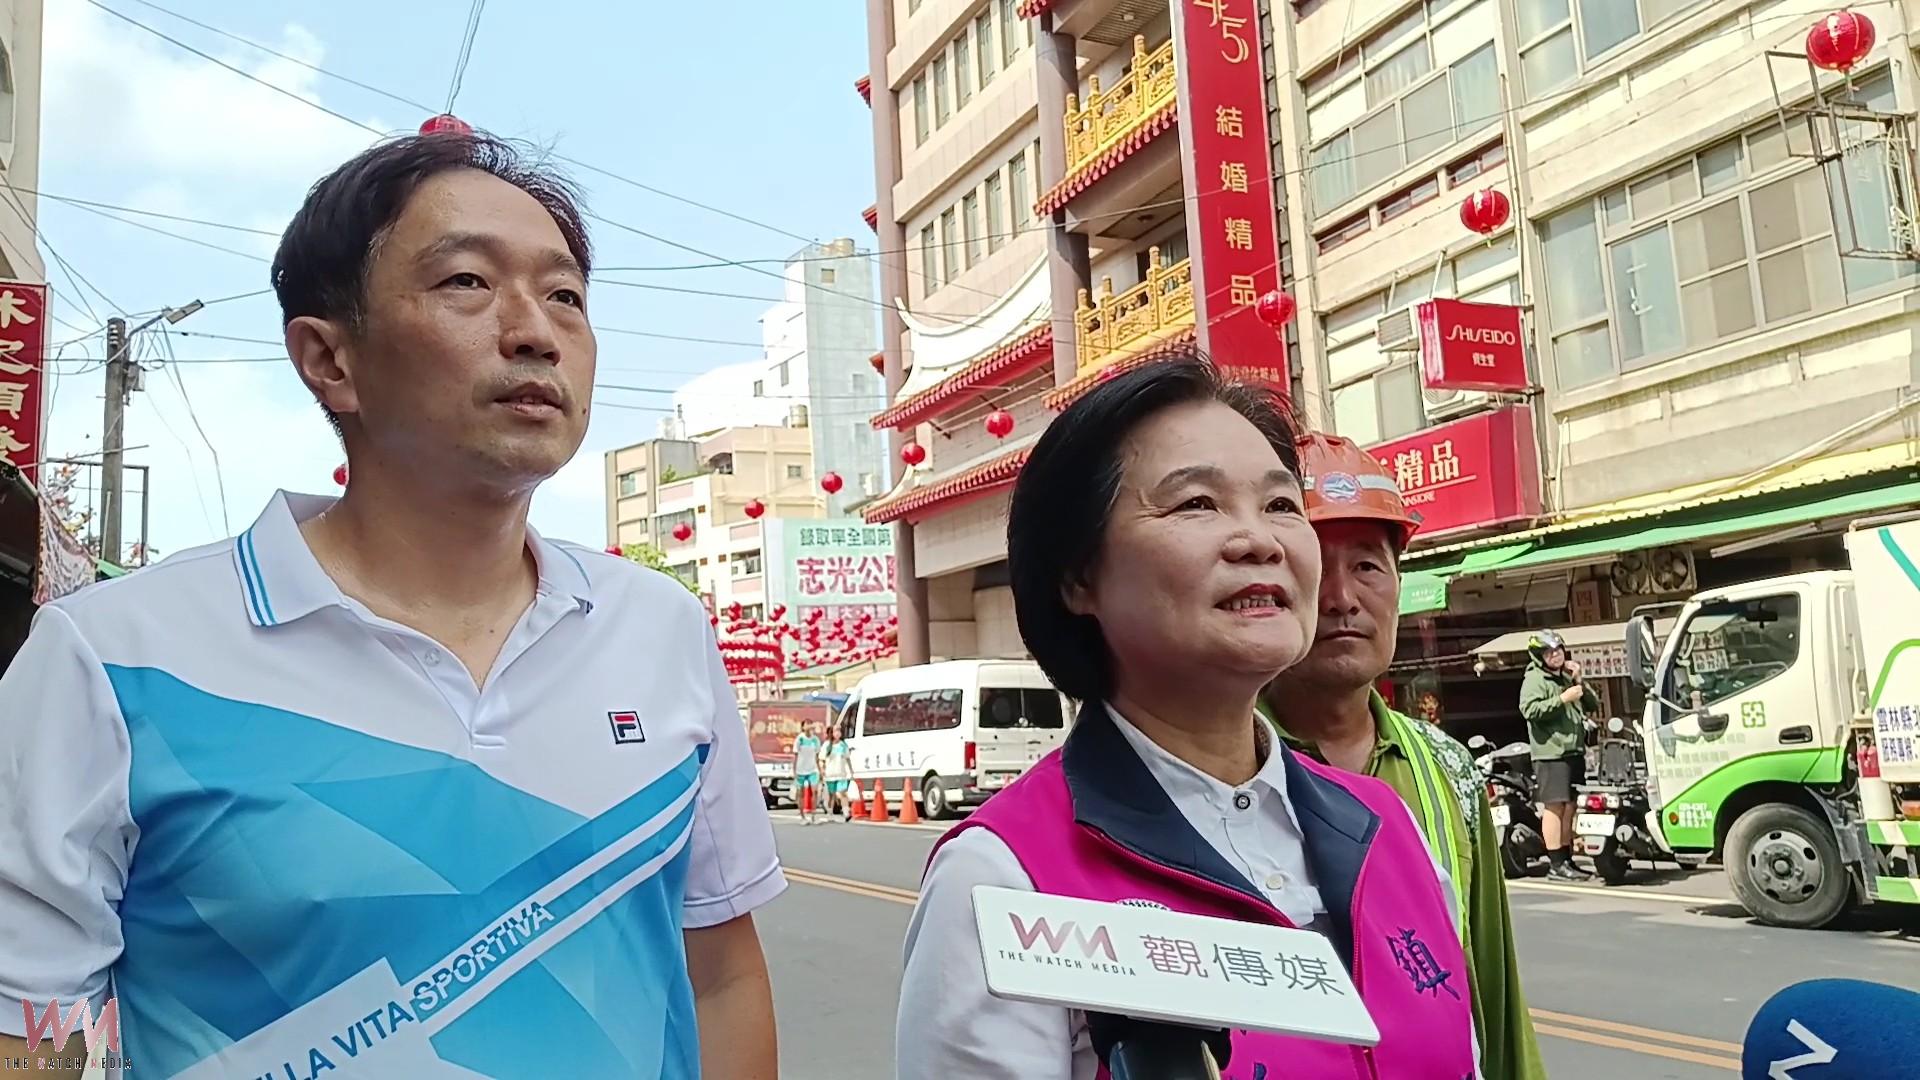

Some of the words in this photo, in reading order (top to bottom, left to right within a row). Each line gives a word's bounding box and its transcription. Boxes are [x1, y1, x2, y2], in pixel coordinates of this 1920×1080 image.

[1206, 105, 1257, 307] 結婚精品
[1445, 324, 1516, 346] SHISEIDO
[1380, 440, 1460, 491] 精品
[999, 949, 1025, 963] THE
[1034, 954, 1083, 969] WATCH
[1091, 962, 1137, 977] MEDIA
[1008, 911, 1118, 963] WM
[331, 1000, 415, 1059] VITA
[412, 901, 556, 1012] SPORTIVA
[1140, 934, 1345, 996] 觀傳媒
